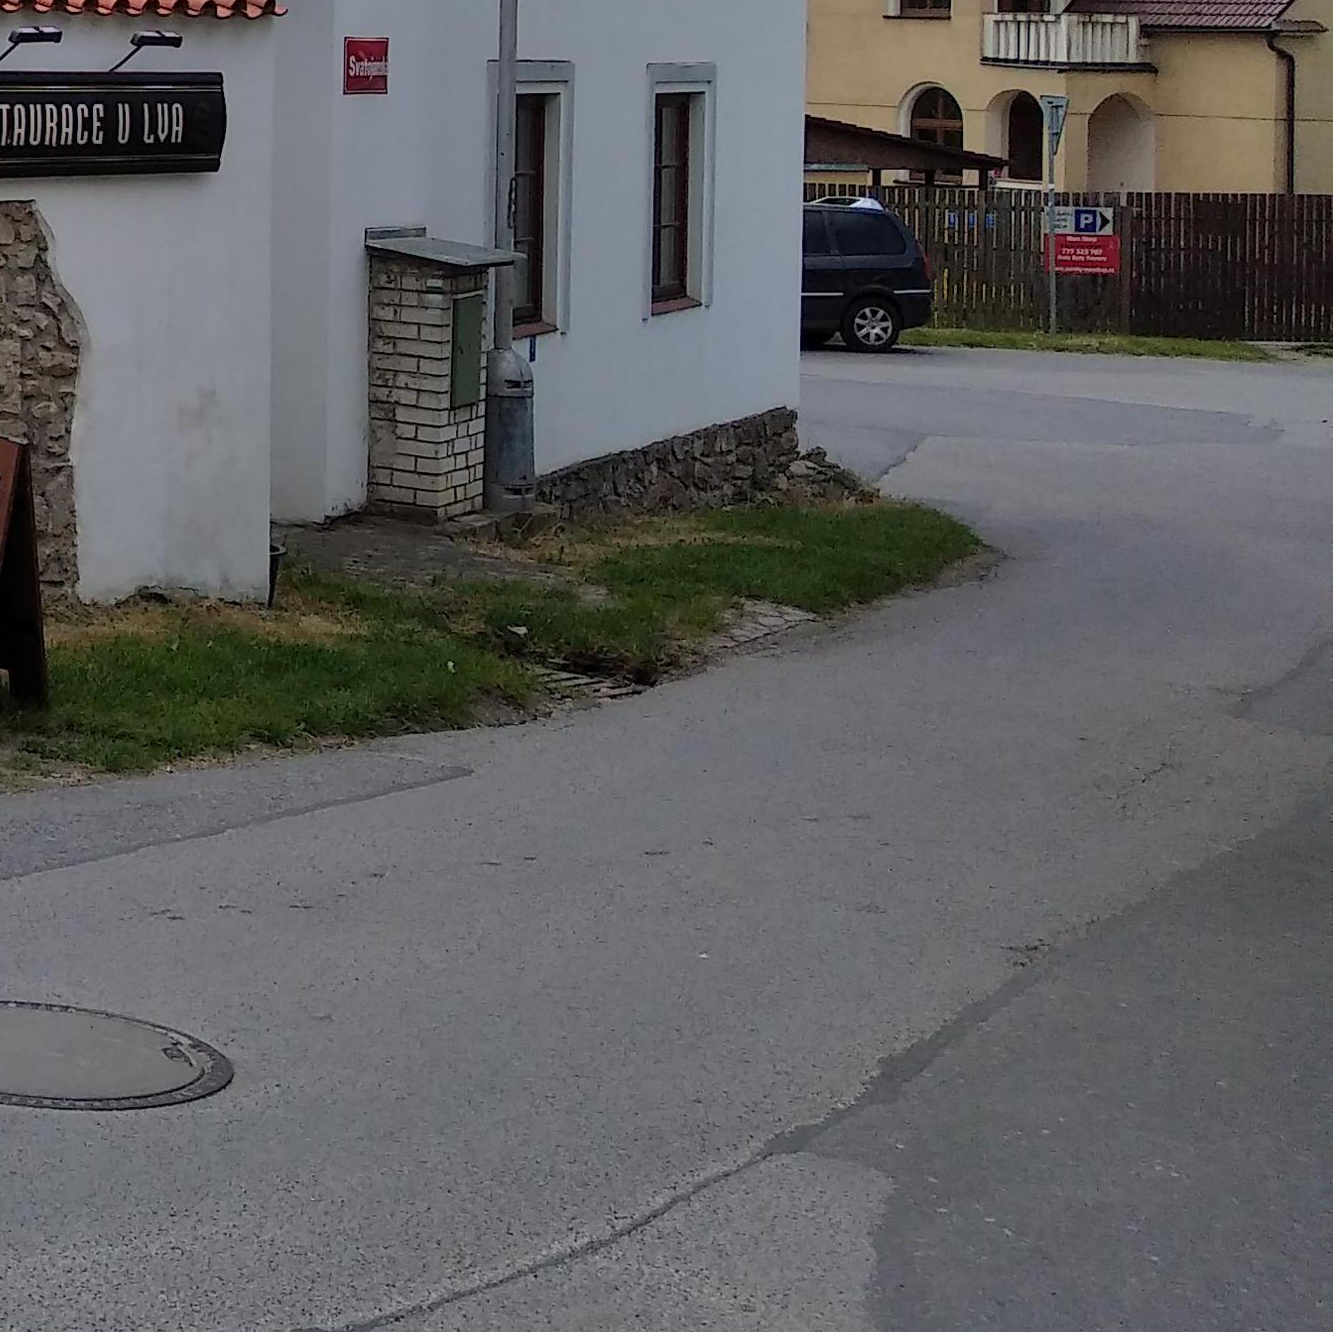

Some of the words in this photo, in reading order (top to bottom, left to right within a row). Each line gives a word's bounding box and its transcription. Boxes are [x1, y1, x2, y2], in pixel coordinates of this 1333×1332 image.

[116, 102, 131, 145] U
[143, 102, 183, 145] LVA
[1080, 213, 1094, 229] P
